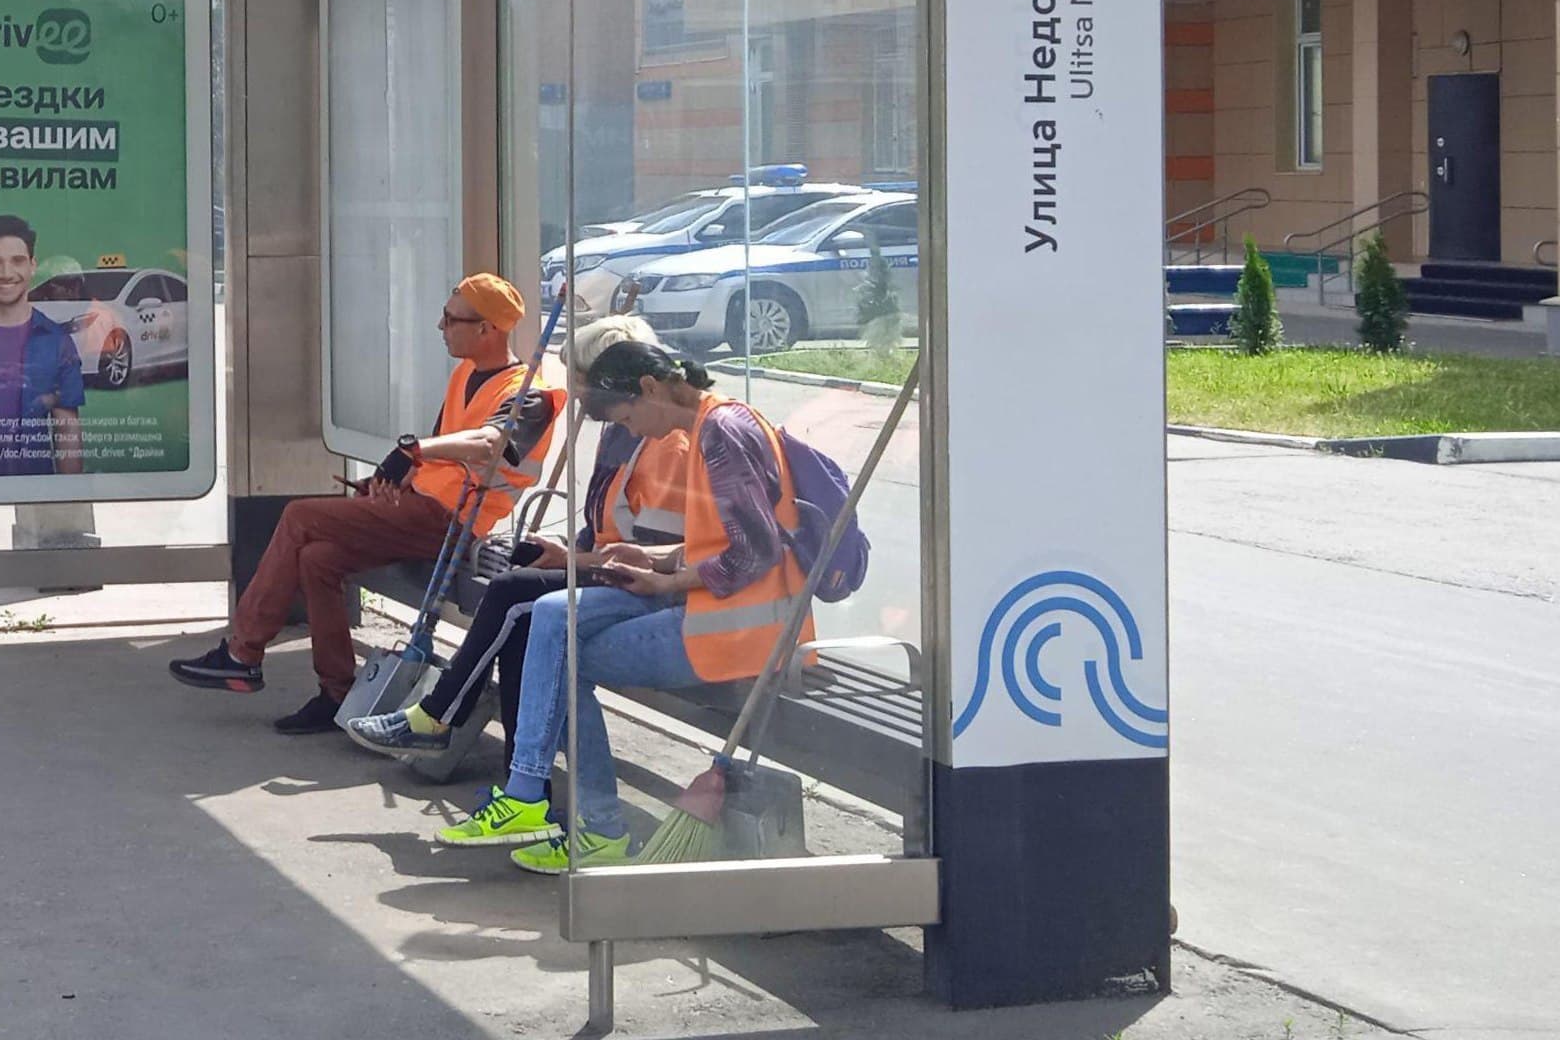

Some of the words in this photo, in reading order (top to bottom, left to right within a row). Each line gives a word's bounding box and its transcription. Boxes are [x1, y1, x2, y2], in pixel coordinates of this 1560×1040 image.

[150, 3, 180, 25] 0+
[1069, 17, 1094, 99] Ulitsa
[1024, 119, 1062, 254] Улица
[840, 256, 909, 270] ПОЛИЯ
